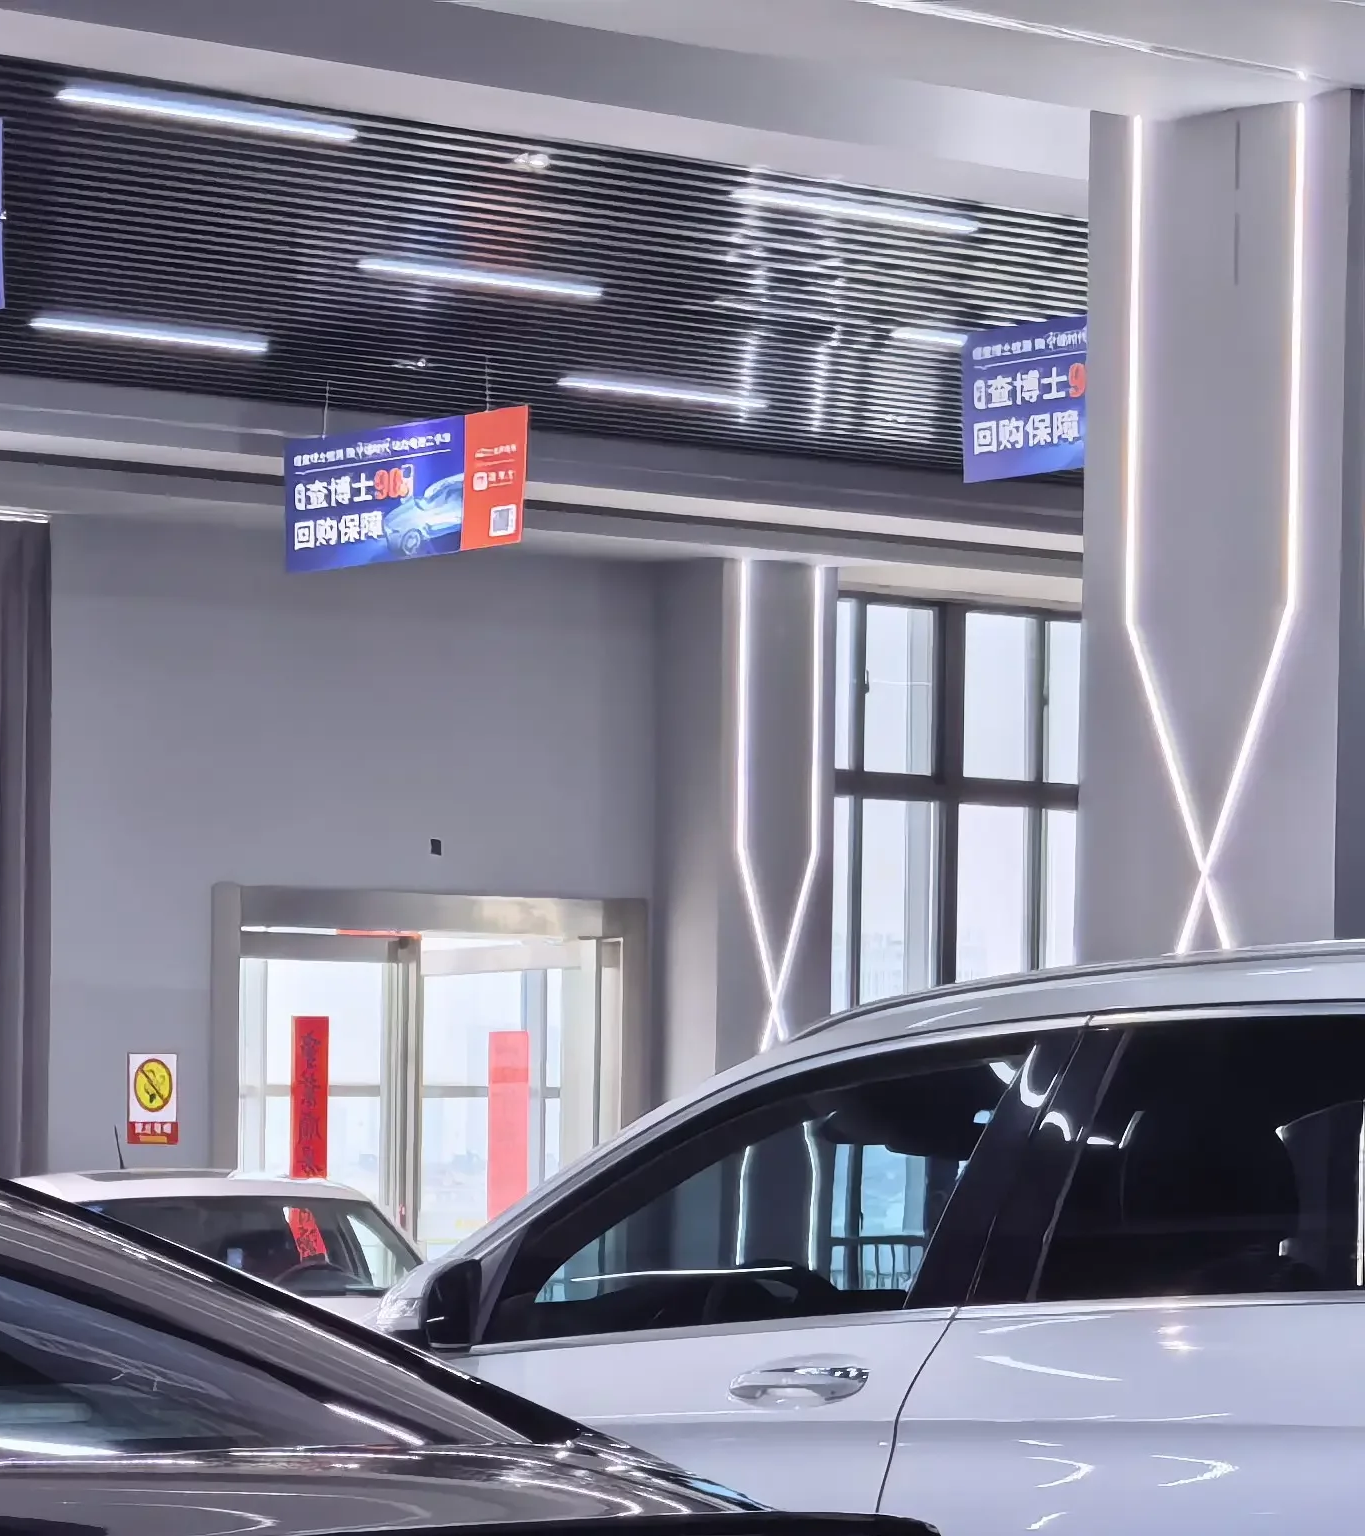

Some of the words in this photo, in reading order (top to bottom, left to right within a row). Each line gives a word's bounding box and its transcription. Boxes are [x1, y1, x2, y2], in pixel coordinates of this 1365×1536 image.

[973, 410, 1080, 455] 回购保障
[294, 511, 384, 550] 回购保障
